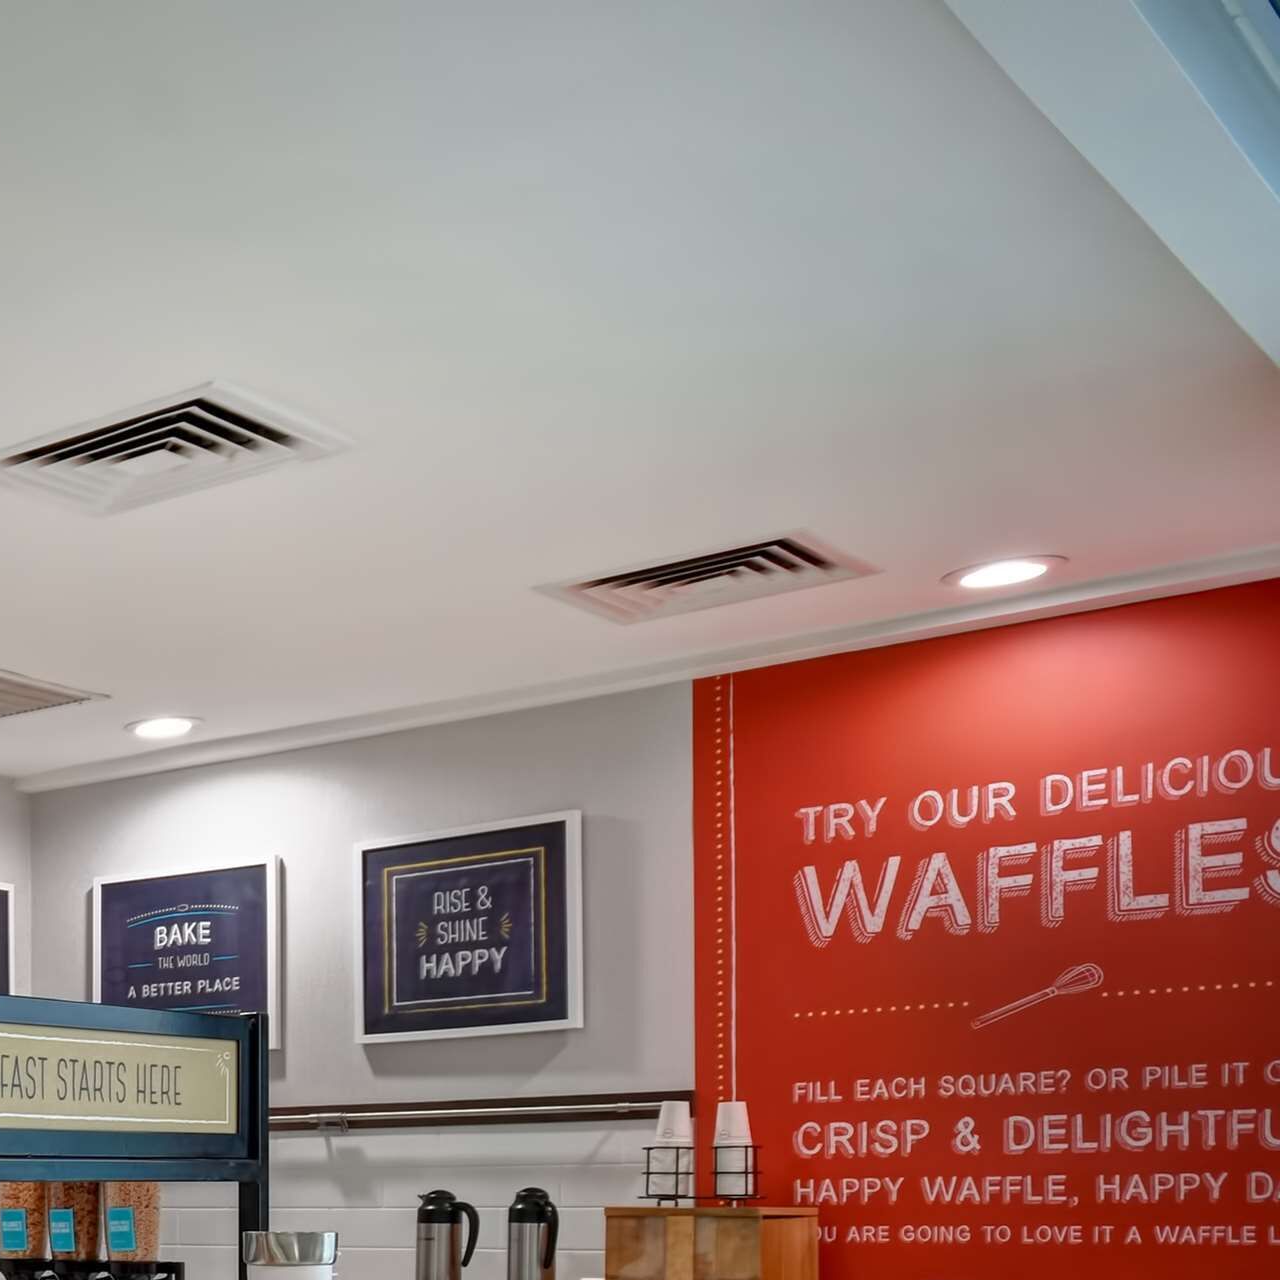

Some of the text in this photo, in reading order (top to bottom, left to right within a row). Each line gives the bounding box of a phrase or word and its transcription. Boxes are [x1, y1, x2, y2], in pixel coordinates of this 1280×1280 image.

[795, 797, 887, 844] TRY
[909, 782, 1017, 831] OUR
[433, 885, 493, 915] RISE &
[154, 921, 212, 950] BAKE
[436, 917, 488, 945] SHINE
[157, 952, 210, 969] THE WORLD
[420, 946, 508, 980] HAPPY
[127, 977, 240, 999] A BETTER PLACE
[56, 1058, 127, 1103] STARTS
[136, 1064, 183, 1106] HERE
[793, 1081, 843, 1103] FILL
[853, 1076, 926, 1100] EACH
[939, 1069, 1071, 1099] SQUARE?
[1086, 1068, 1129, 1093] OR
[1142, 1064, 1209, 1089] PILE
[1221, 1062, 1250, 1087] IT
[793, 1119, 930, 1159] CRISP
[953, 1116, 982, 1156] &
[793, 1171, 1280, 1208] HAPPY WAFFLE, HAPPY D
[846, 1225, 890, 1244] ARE
[900, 1225, 971, 1244] GOING
[983, 1225, 1011, 1244] TO
[1021, 1225, 1083, 1245] LOVE
[1093, 1226, 1115, 1244] IT
[1124, 1226, 1142, 1244] A
[1155, 1225, 1257, 1245] WAFFLE
